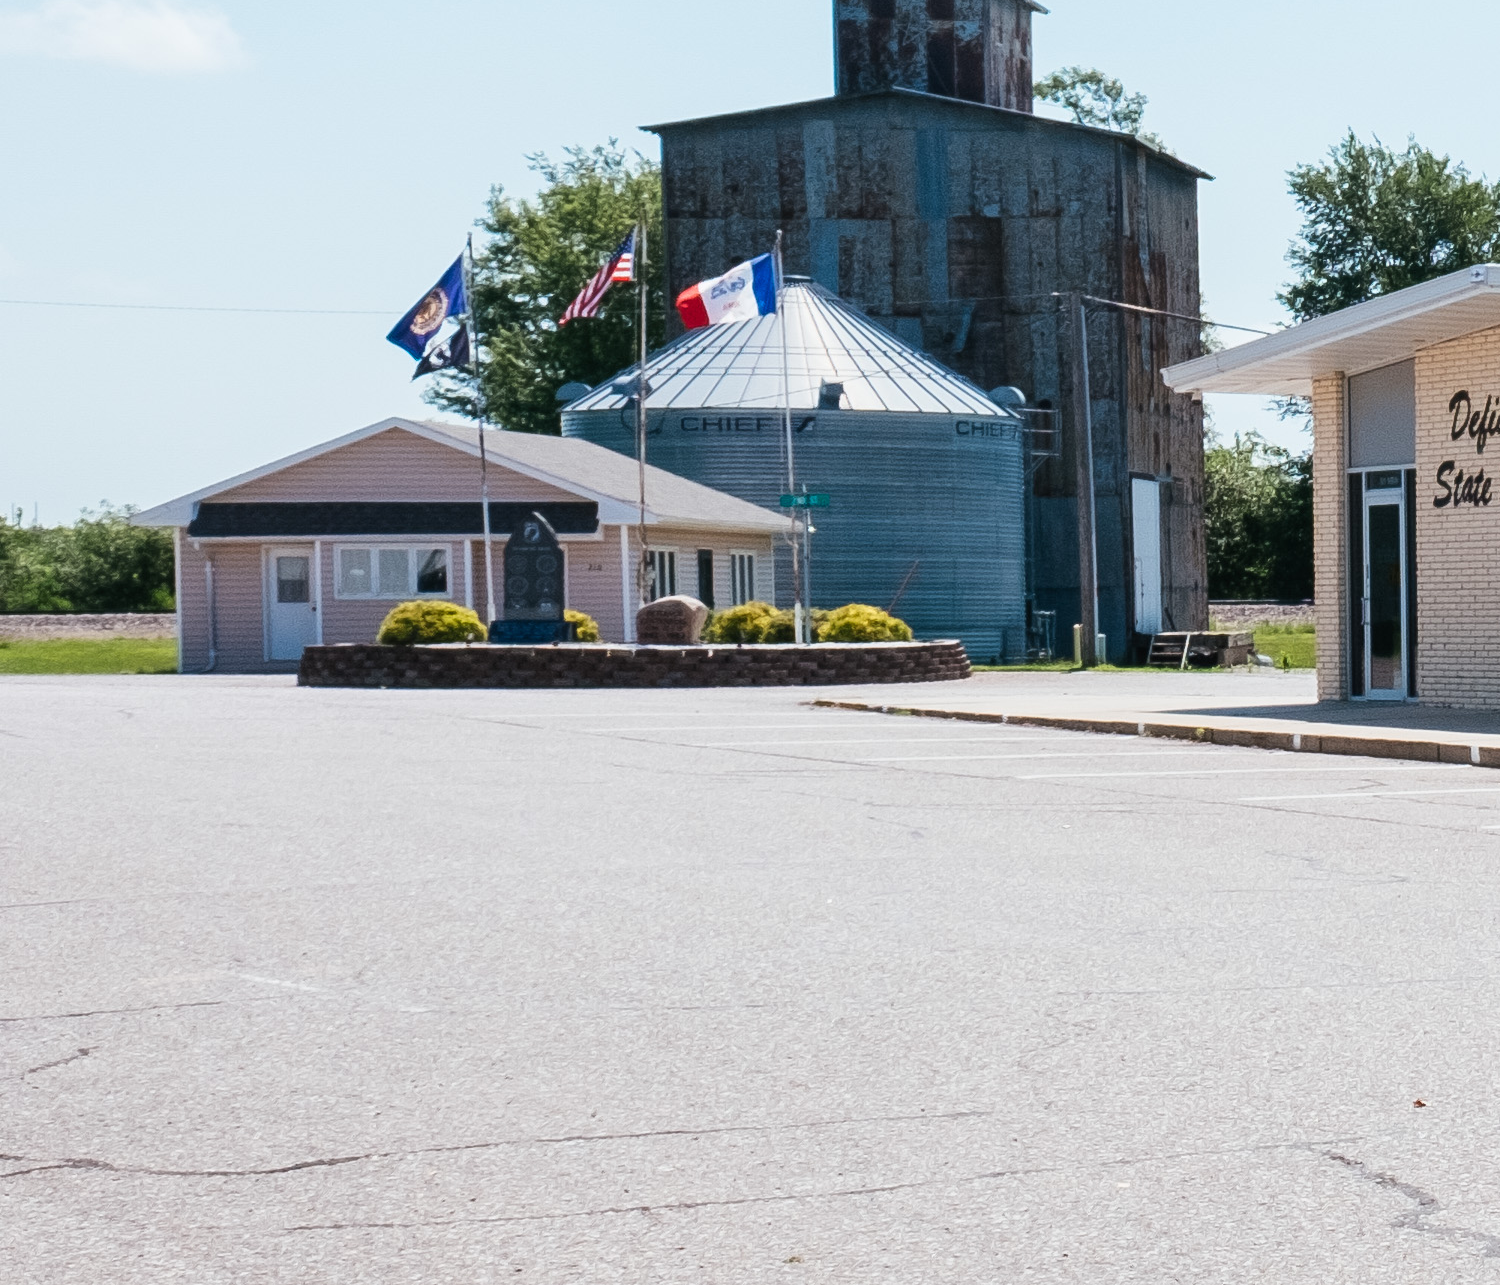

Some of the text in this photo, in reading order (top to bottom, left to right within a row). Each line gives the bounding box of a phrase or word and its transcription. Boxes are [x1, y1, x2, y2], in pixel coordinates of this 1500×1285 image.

[680, 417, 774, 432] CHIEF
[956, 421, 1010, 437] CHIEF
[1433, 460, 1492, 508] State
